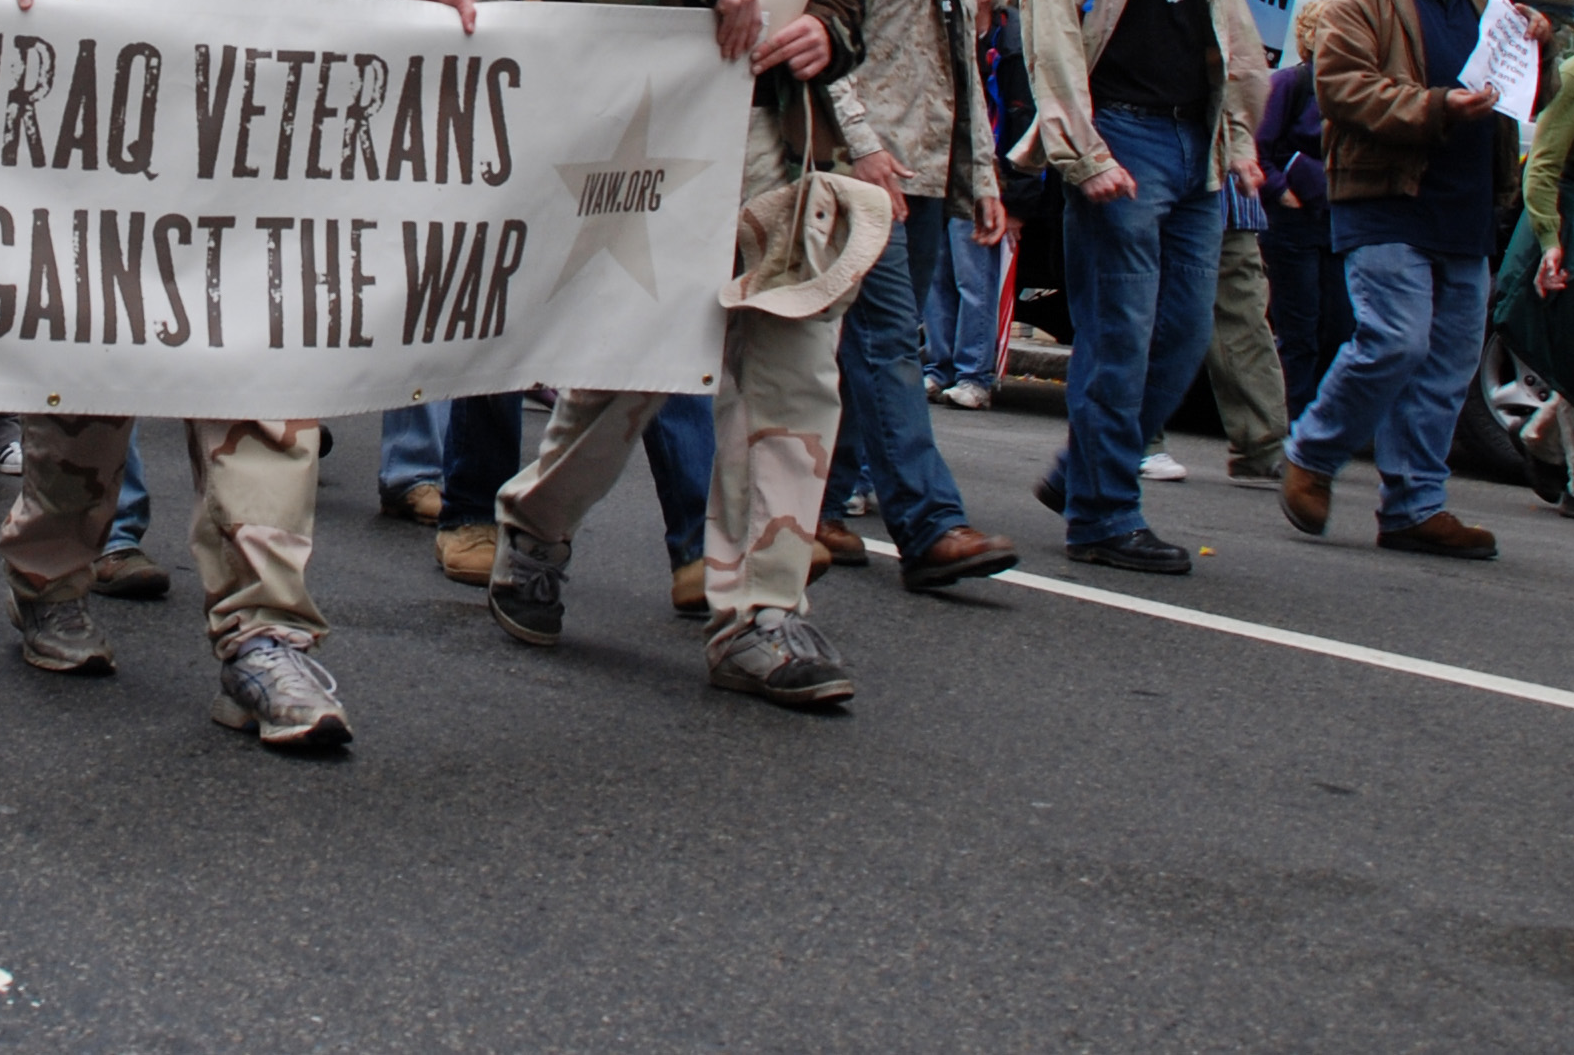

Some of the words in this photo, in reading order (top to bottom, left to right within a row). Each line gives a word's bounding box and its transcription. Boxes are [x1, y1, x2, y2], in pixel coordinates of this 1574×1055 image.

[194, 43, 522, 187] VETERANS
[576, 169, 665, 217] IVAW.ORG
[255, 215, 379, 349] THE
[402, 218, 529, 347] WAR
